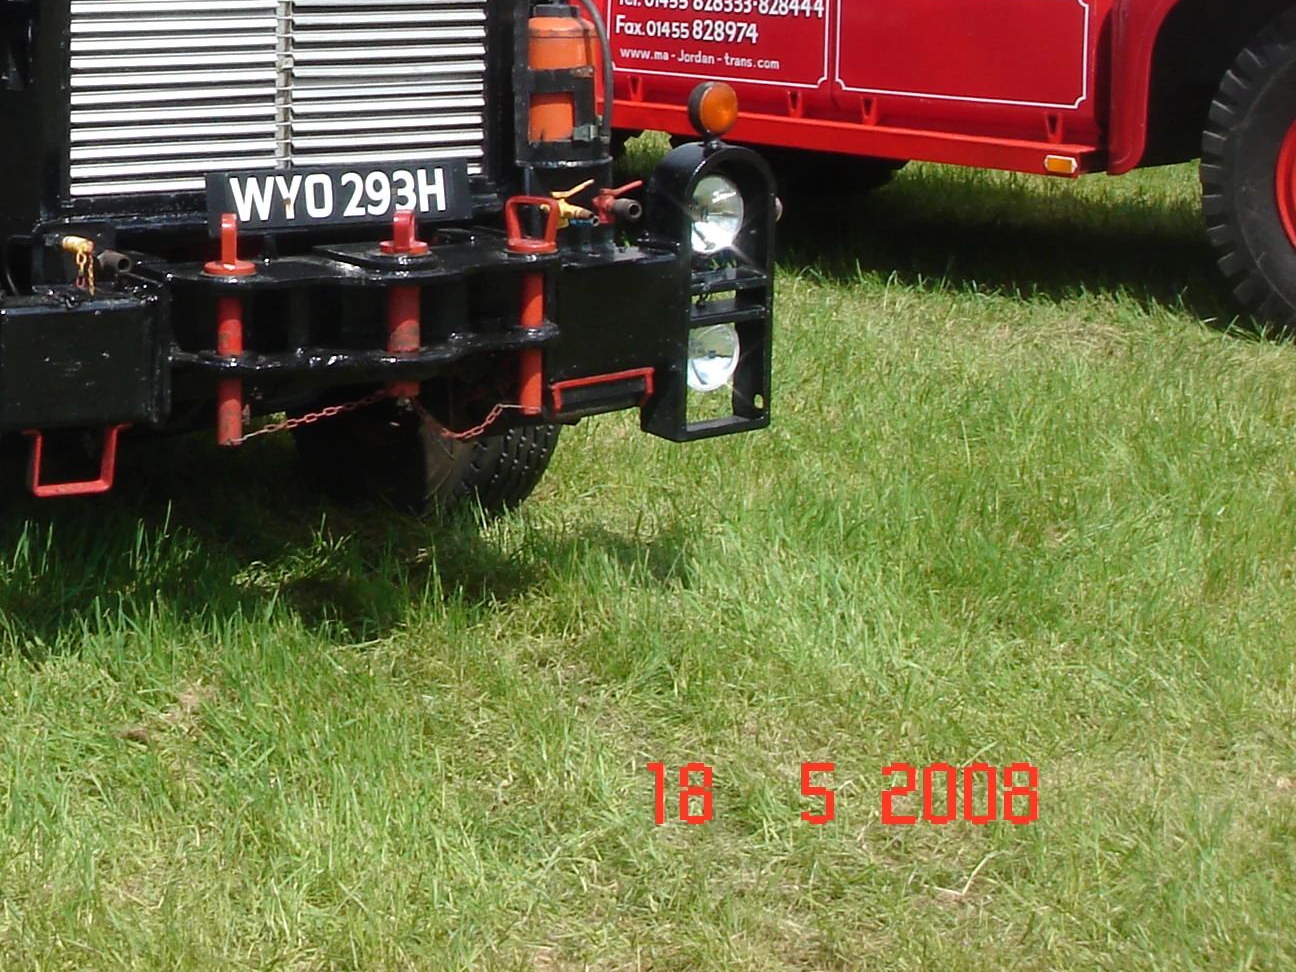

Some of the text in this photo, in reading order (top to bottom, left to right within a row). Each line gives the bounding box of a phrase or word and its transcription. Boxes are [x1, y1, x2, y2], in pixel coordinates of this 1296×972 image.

[692, 19, 759, 44] 828974
[229, 167, 446, 222] WYO 293H
